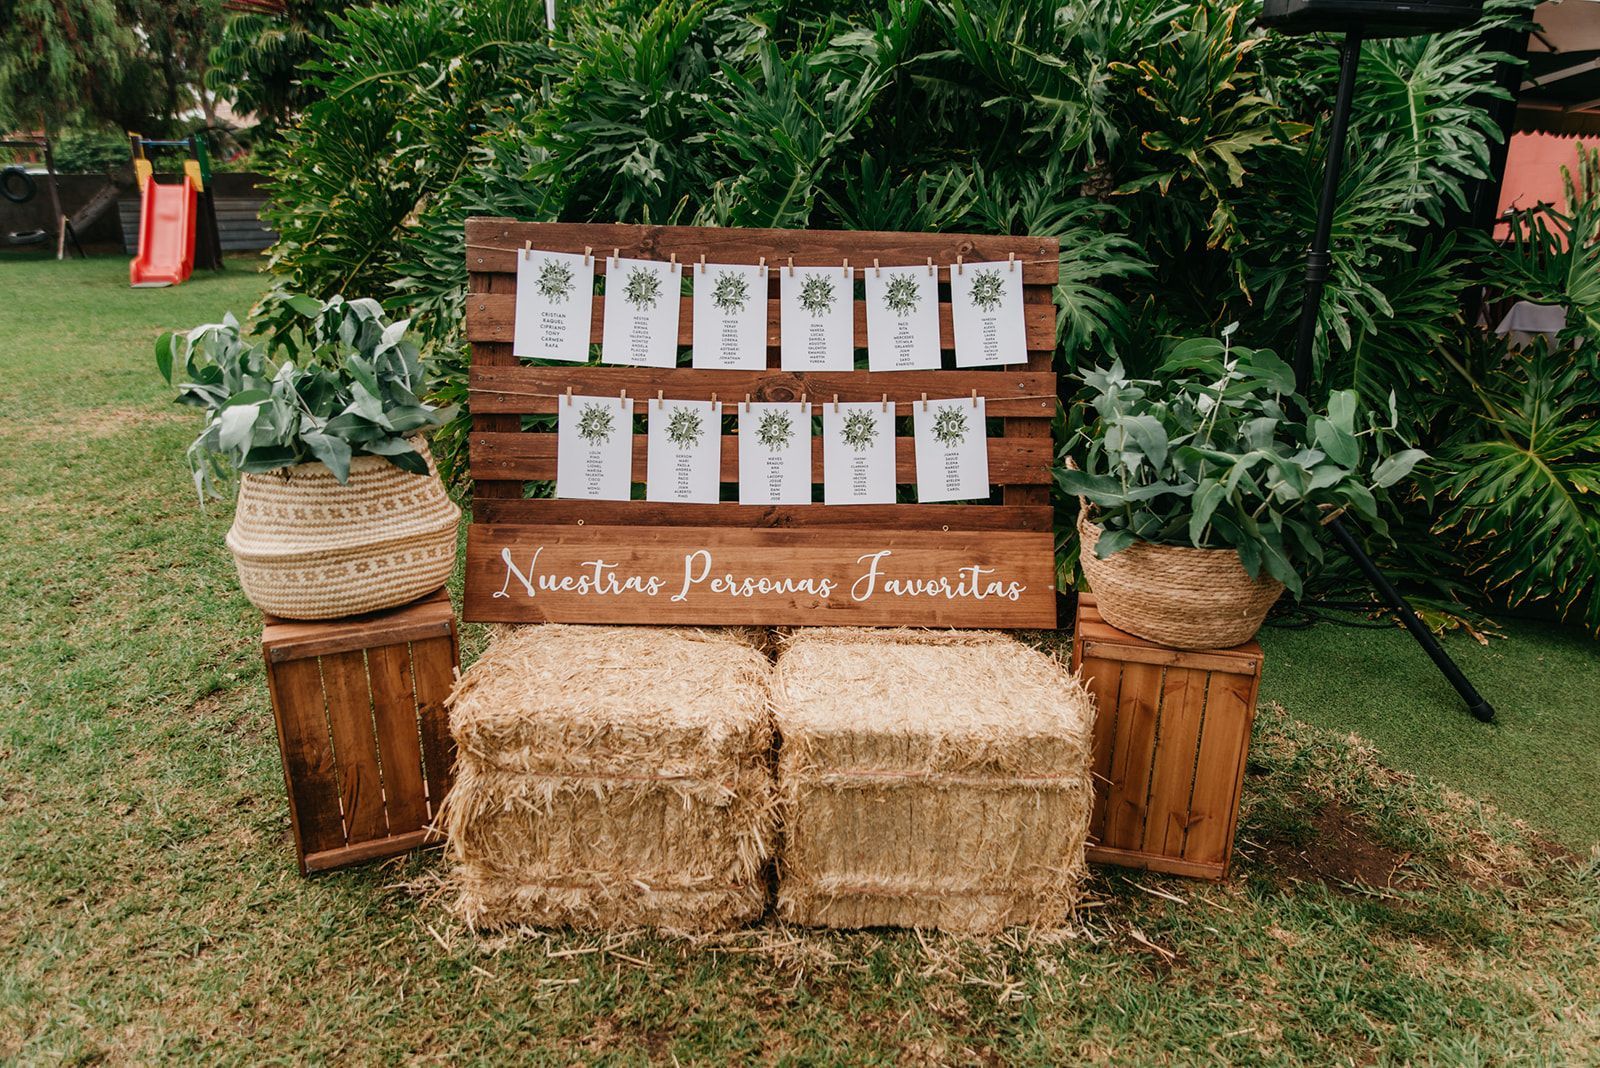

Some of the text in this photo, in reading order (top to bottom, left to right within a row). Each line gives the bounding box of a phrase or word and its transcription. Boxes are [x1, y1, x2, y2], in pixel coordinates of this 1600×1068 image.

[641, 283, 646, 295] 1
[727, 287, 735, 299] 2
[813, 289, 822, 301] 3
[898, 289, 907, 300] 4
[984, 284, 992, 297] 5
[592, 418, 600, 430] 6
[681, 421, 689, 434] 7
[771, 424, 779, 436] 8
[855, 424, 864, 436] 9
[943, 420, 959, 433] 10
[493, 547, 1027, 602] Nuestras Personas Favoritas
